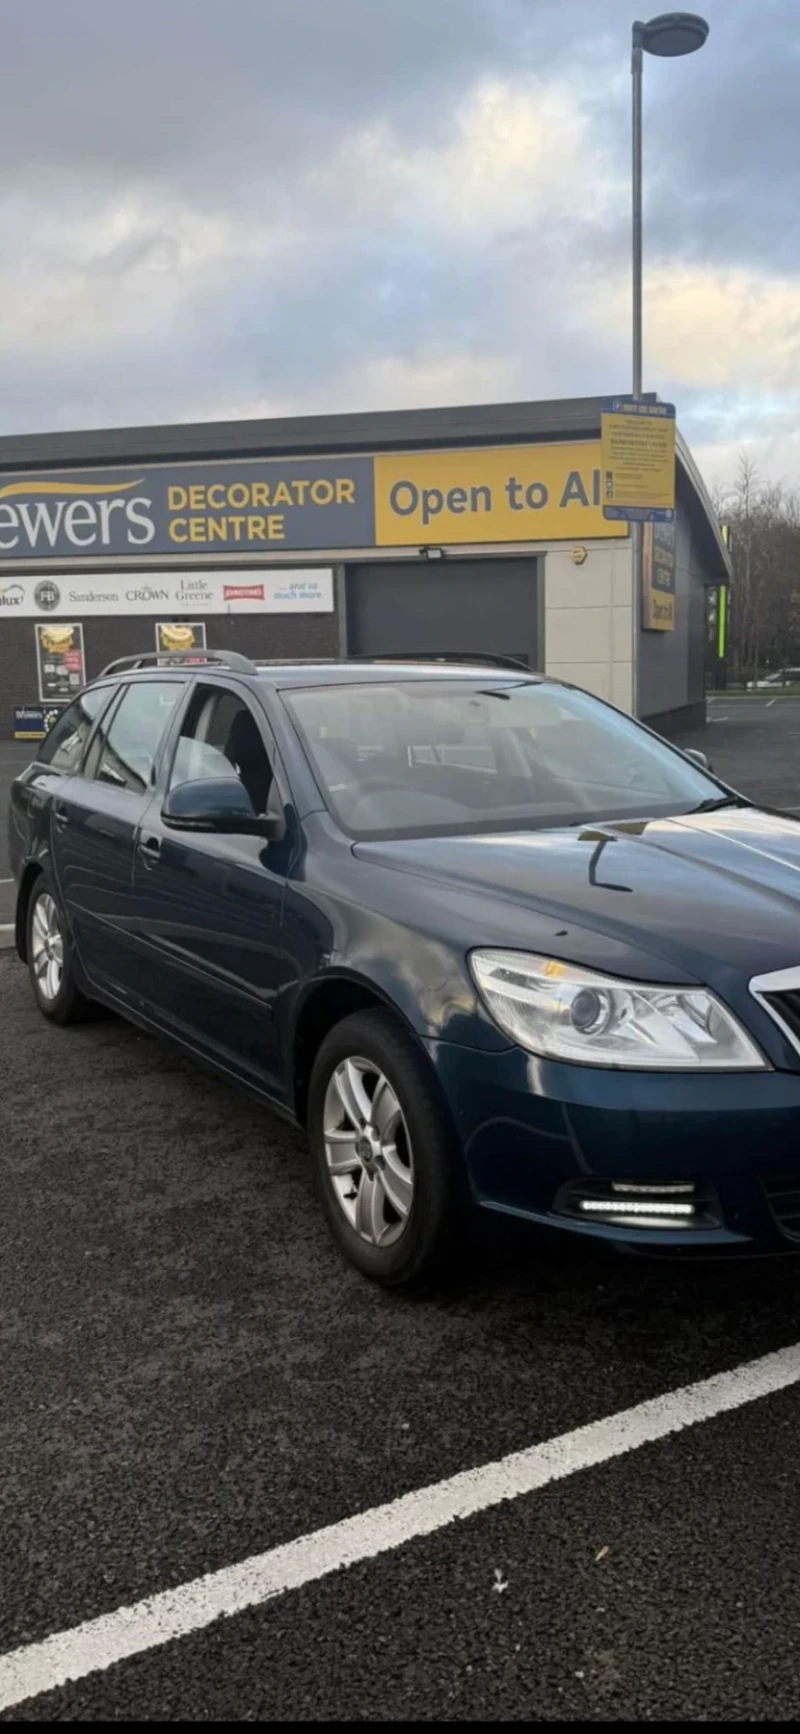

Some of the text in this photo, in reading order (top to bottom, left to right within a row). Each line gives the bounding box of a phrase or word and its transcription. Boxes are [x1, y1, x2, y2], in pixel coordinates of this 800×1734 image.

[167, 479, 355, 511] DECORATOR
[389, 469, 600, 525] Open to Al
[0, 497, 155, 549] ewers
[168, 515, 285, 543] CENTRE
[180, 578, 208, 590] Little
[0, 595, 20, 606] lux
[69, 588, 119, 602] Sanderson
[125, 589, 170, 601] CROWN
[175, 590, 213, 601] Greene
